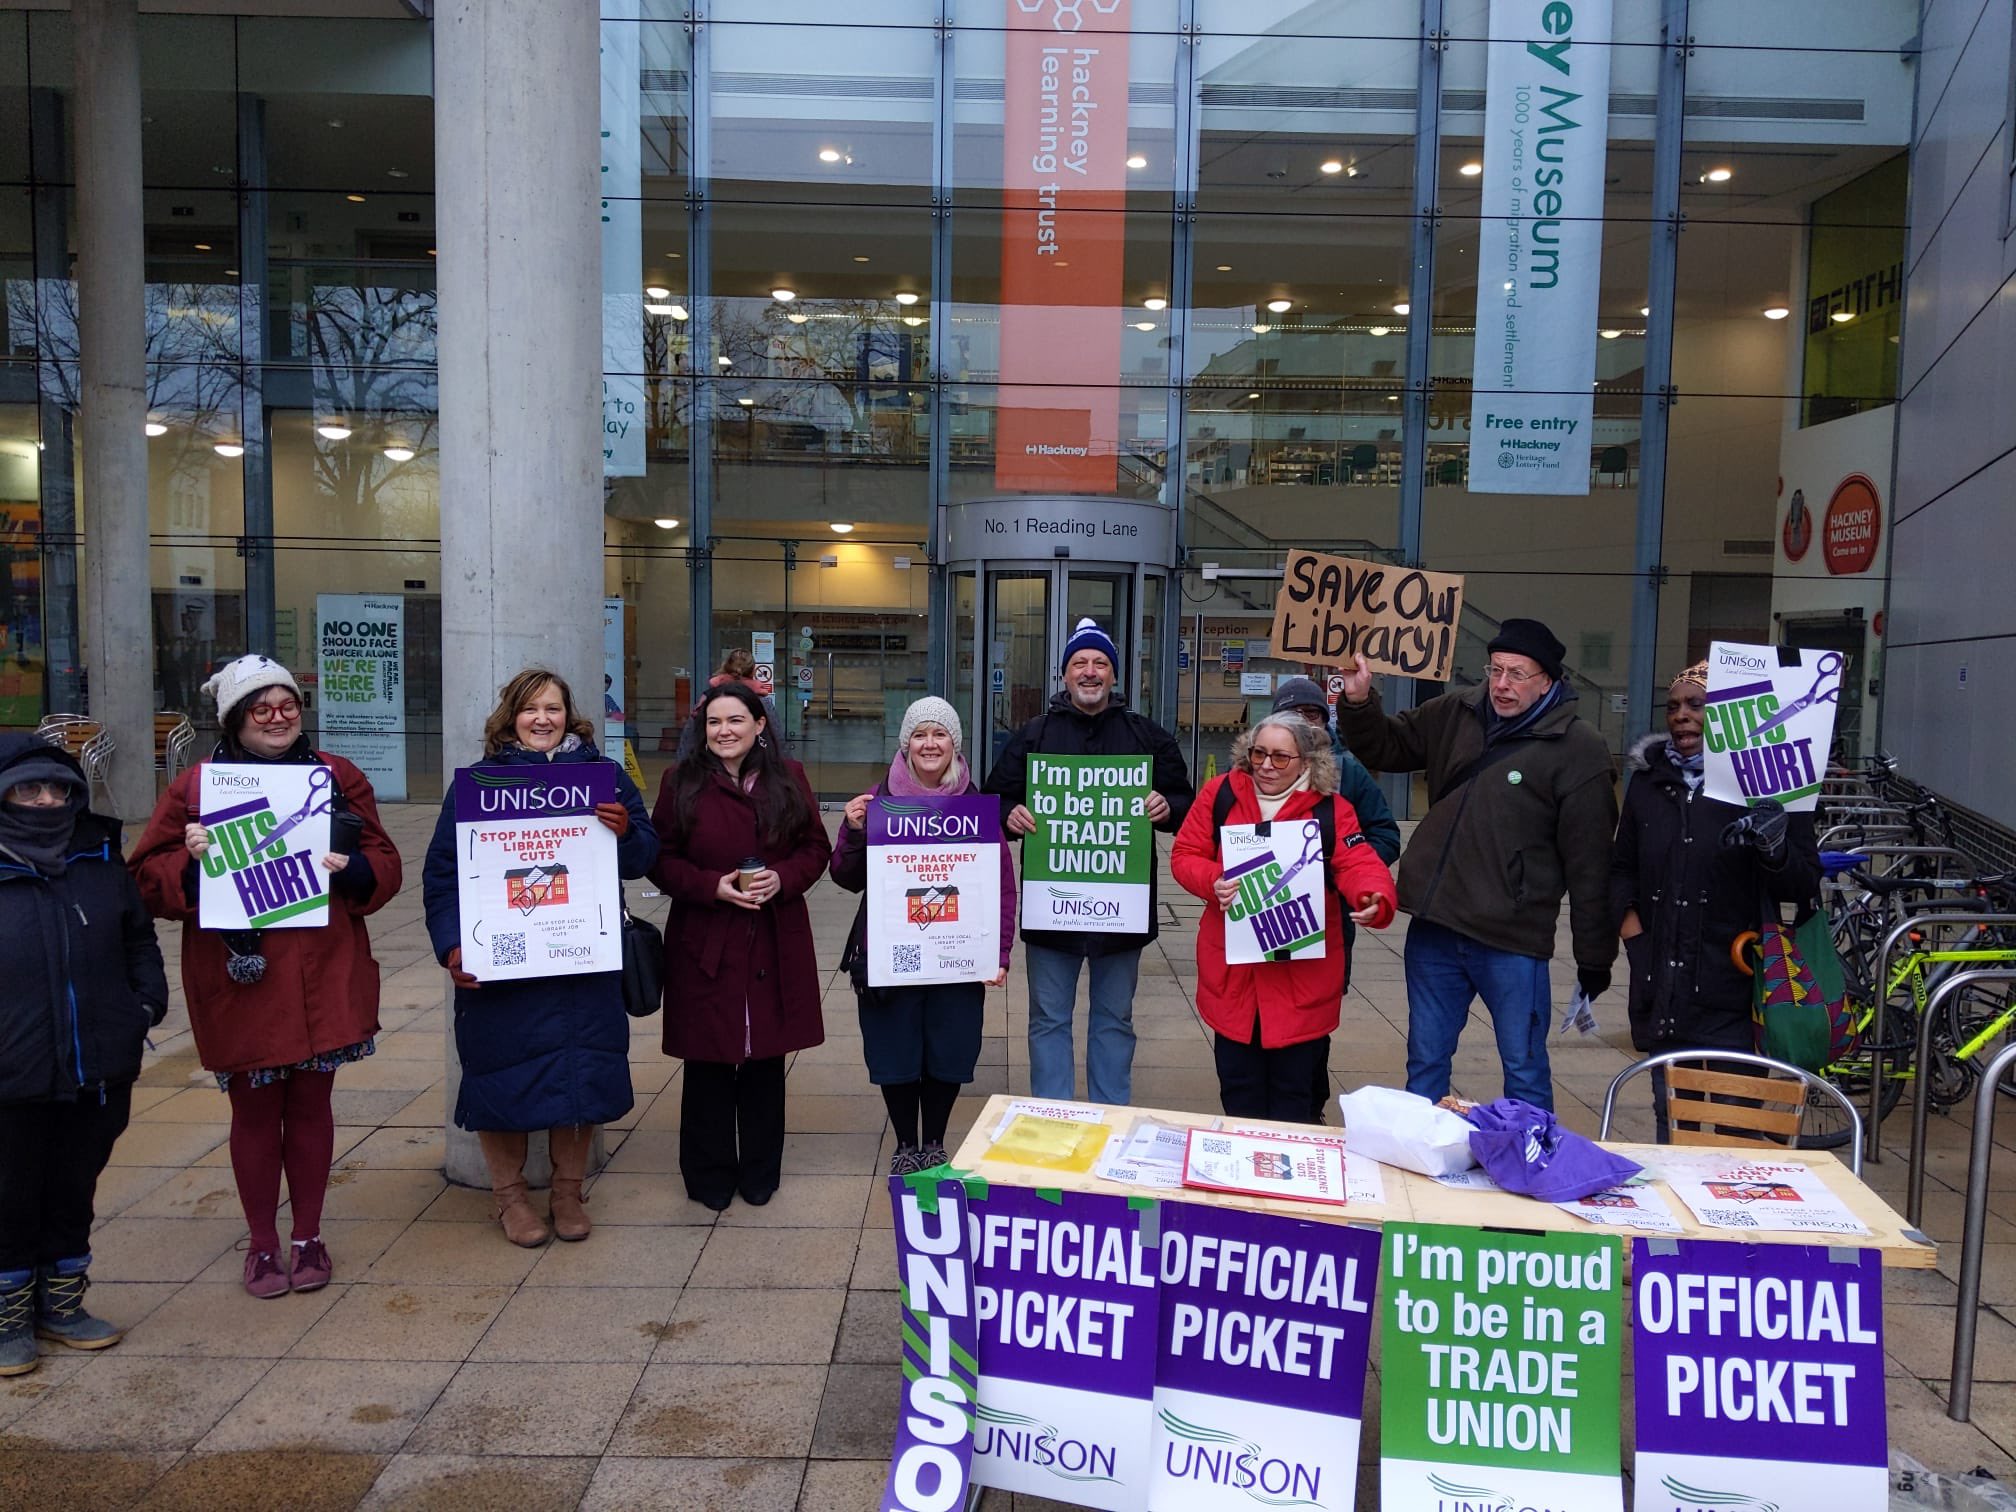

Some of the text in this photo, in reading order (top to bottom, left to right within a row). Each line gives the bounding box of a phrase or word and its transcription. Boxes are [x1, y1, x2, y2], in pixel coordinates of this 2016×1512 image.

[1064, 48, 1099, 175] hackney
[1032, 48, 1068, 255] learning trust
[1529, 85, 1584, 288] Museum
[1503, 84, 1531, 388] 1000 years of migration and settlement
[614, 397, 635, 414] to
[1486, 414, 1524, 430] Free
[1530, 416, 1578, 435] entry
[1038, 444, 1088, 456] Hackney
[1512, 439, 1560, 452] Hackney
[1516, 454, 1547, 463] Heritage
[1516, 461, 1560, 470] Lottery Fund
[985, 518, 1138, 538] No. 1 Reading Lane
[1831, 510, 1873, 528] HACKNEY
[1831, 526, 1871, 544] MUSEUM
[1832, 544, 1865, 557] Come on in
[324, 621, 398, 638] NO ONE
[322, 637, 398, 648] SHOULD FACE
[322, 648, 399, 659] CANCER ALONE
[1720, 655, 1766, 669] UNISON
[323, 659, 377, 673] WE'RE
[325, 674, 375, 691] HERE
[325, 691, 377, 703] TO HELP
[1704, 694, 1787, 753] CUTS
[1730, 737, 1816, 797] HURT
[212, 776, 260, 787] UNISON
[1078, 762, 1148, 792] proud
[480, 785, 590, 812] UNISON
[1032, 790, 1145, 816] to be in a
[480, 827, 588, 842] STOP HACKNEY
[887, 815, 979, 837] UNISON
[1047, 819, 1131, 846] TRADE
[201, 811, 288, 879] CUTS
[503, 839, 563, 852] LIBRARY
[519, 851, 555, 862] CUTS
[887, 853, 977, 863] STOP HACKNEY
[1049, 848, 1126, 874] UNION
[906, 863, 955, 873] LIBRARY
[919, 873, 949, 882] CUTS
[232, 849, 322, 918] HURT
[1052, 899, 1120, 916] UNISON
[1063, 918, 1082, 927] public
[1249, 893, 1320, 953] HURT
[549, 946, 591, 958] UNISON
[939, 959, 975, 969] UNISON
[1792, 1220, 1858, 1231] UNISON
[1160, 1231, 1368, 1314] OFFICIAL
[1478, 1246, 1612, 1293] proud
[1395, 1289, 1605, 1345] to be in a
[1639, 1271, 1877, 1344] OFFICIAL
[977, 1286, 1134, 1360] PICKET
[1171, 1303, 1345, 1380] PICKET
[1421, 1343, 1578, 1398] TRADE
[1666, 1354, 1856, 1426] PICKET
[1427, 1398, 1571, 1454] UNION
[1166, 1441, 1321, 1501] UNISON
